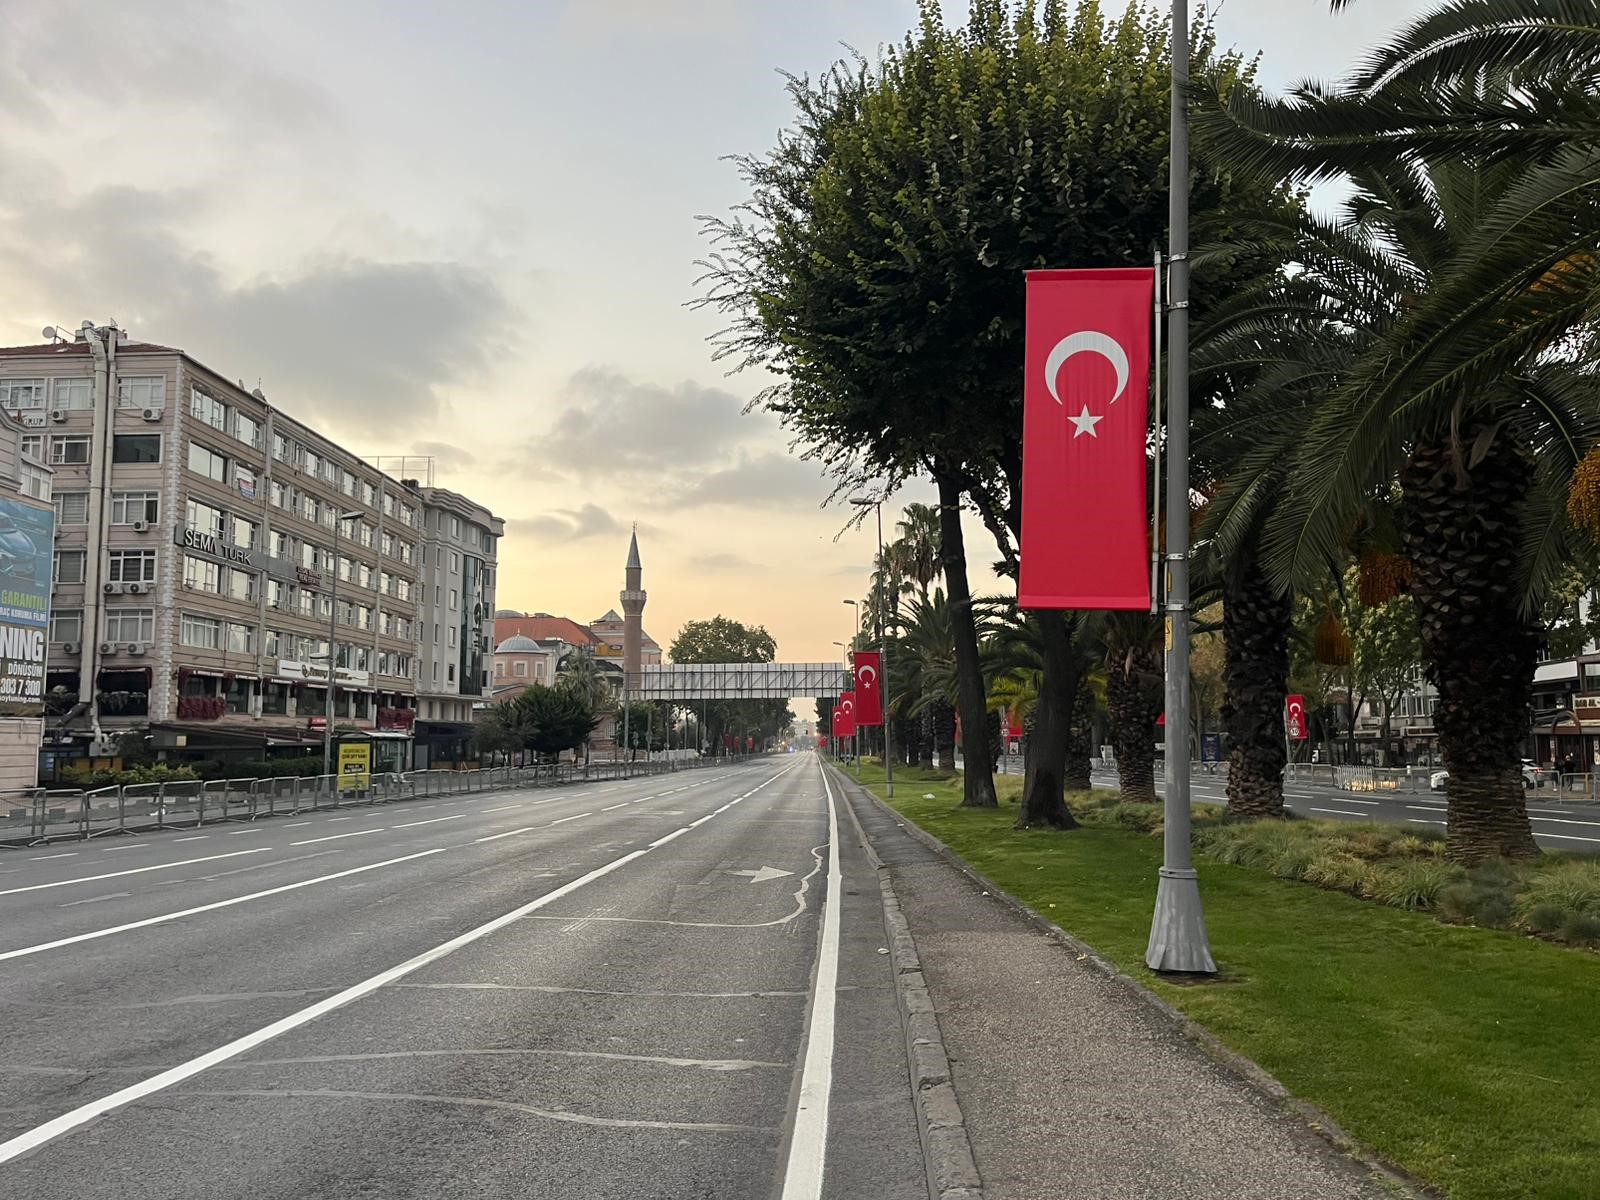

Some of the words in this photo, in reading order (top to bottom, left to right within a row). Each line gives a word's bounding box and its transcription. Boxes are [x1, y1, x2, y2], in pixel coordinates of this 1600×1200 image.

[184, 529, 216, 554] SEMA
[0, 626, 44, 662] NING
[18, 679, 24, 695] 7
[25, 680, 41, 696] 300
